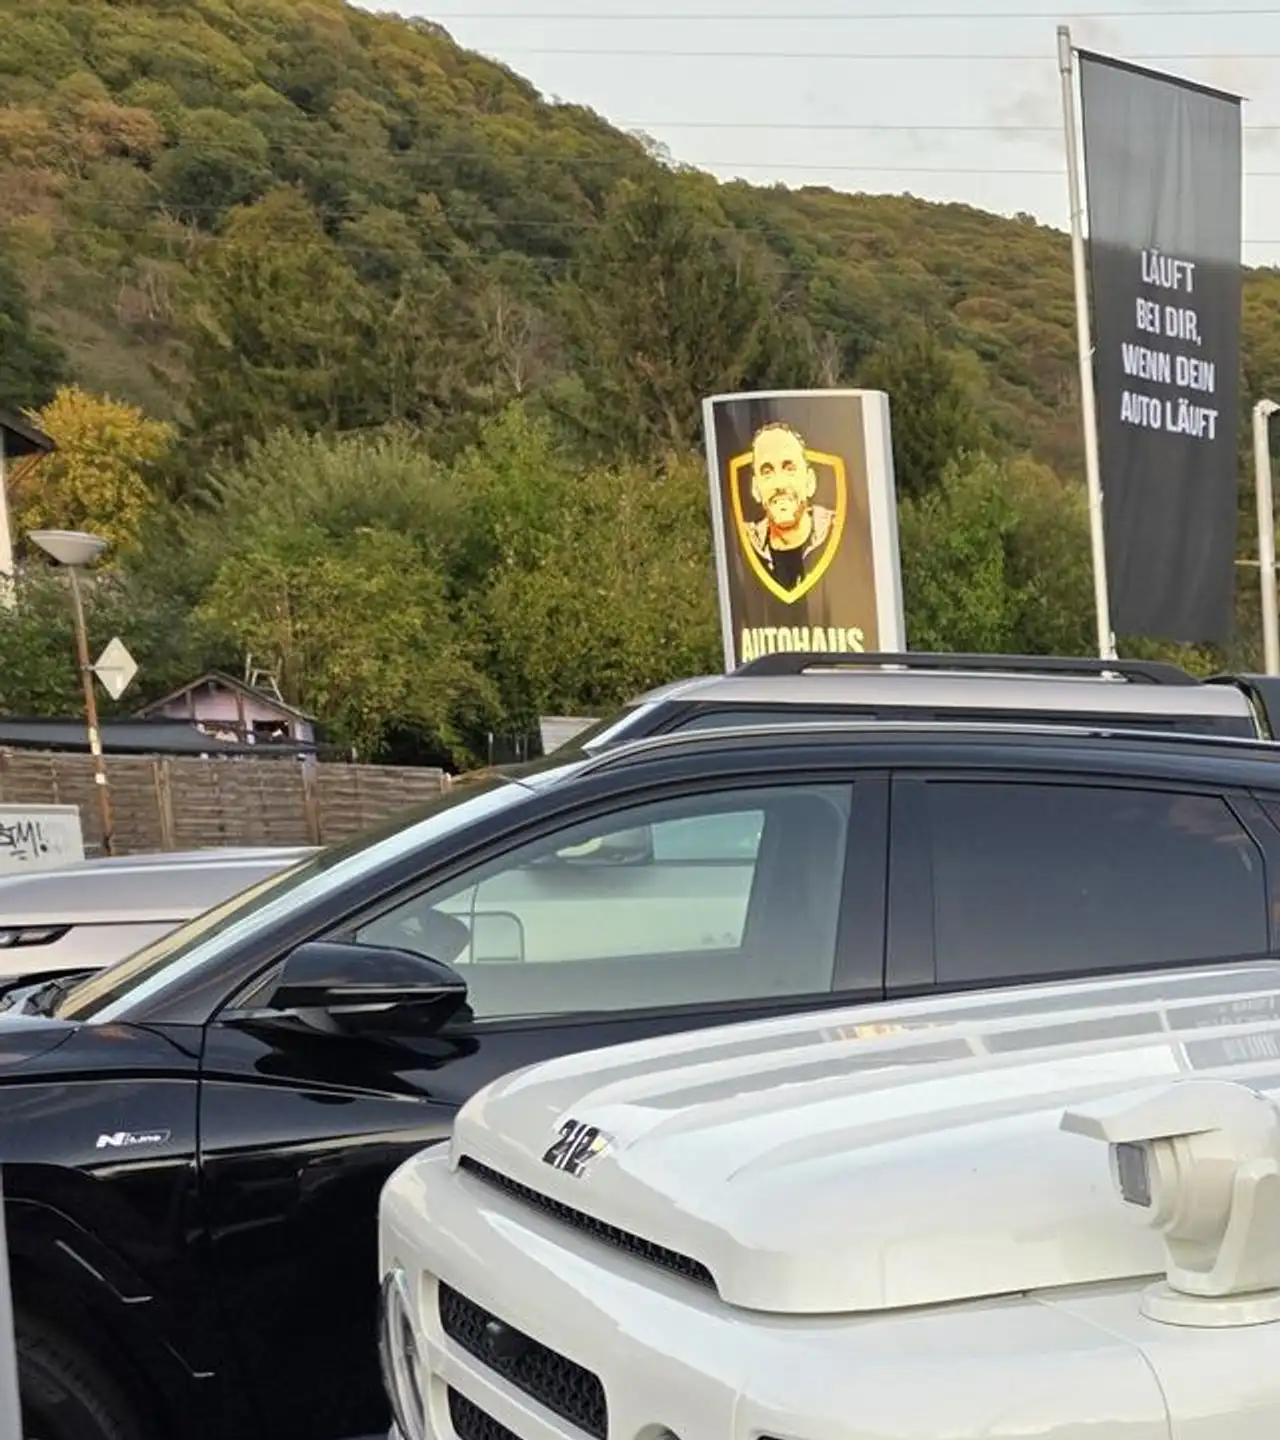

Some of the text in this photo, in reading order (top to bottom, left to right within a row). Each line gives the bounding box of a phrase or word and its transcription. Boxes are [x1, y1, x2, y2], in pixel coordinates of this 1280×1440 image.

[1142, 249, 1195, 293] LÄUFT
[1136, 297, 1202, 347] BEI DIR,
[1121, 342, 1215, 393] WENN DEIN
[1121, 391, 1219, 440] AUTO LÄUFT
[742, 627, 865, 664] AUTOHAUS
[543, 1119, 601, 1178] 212
